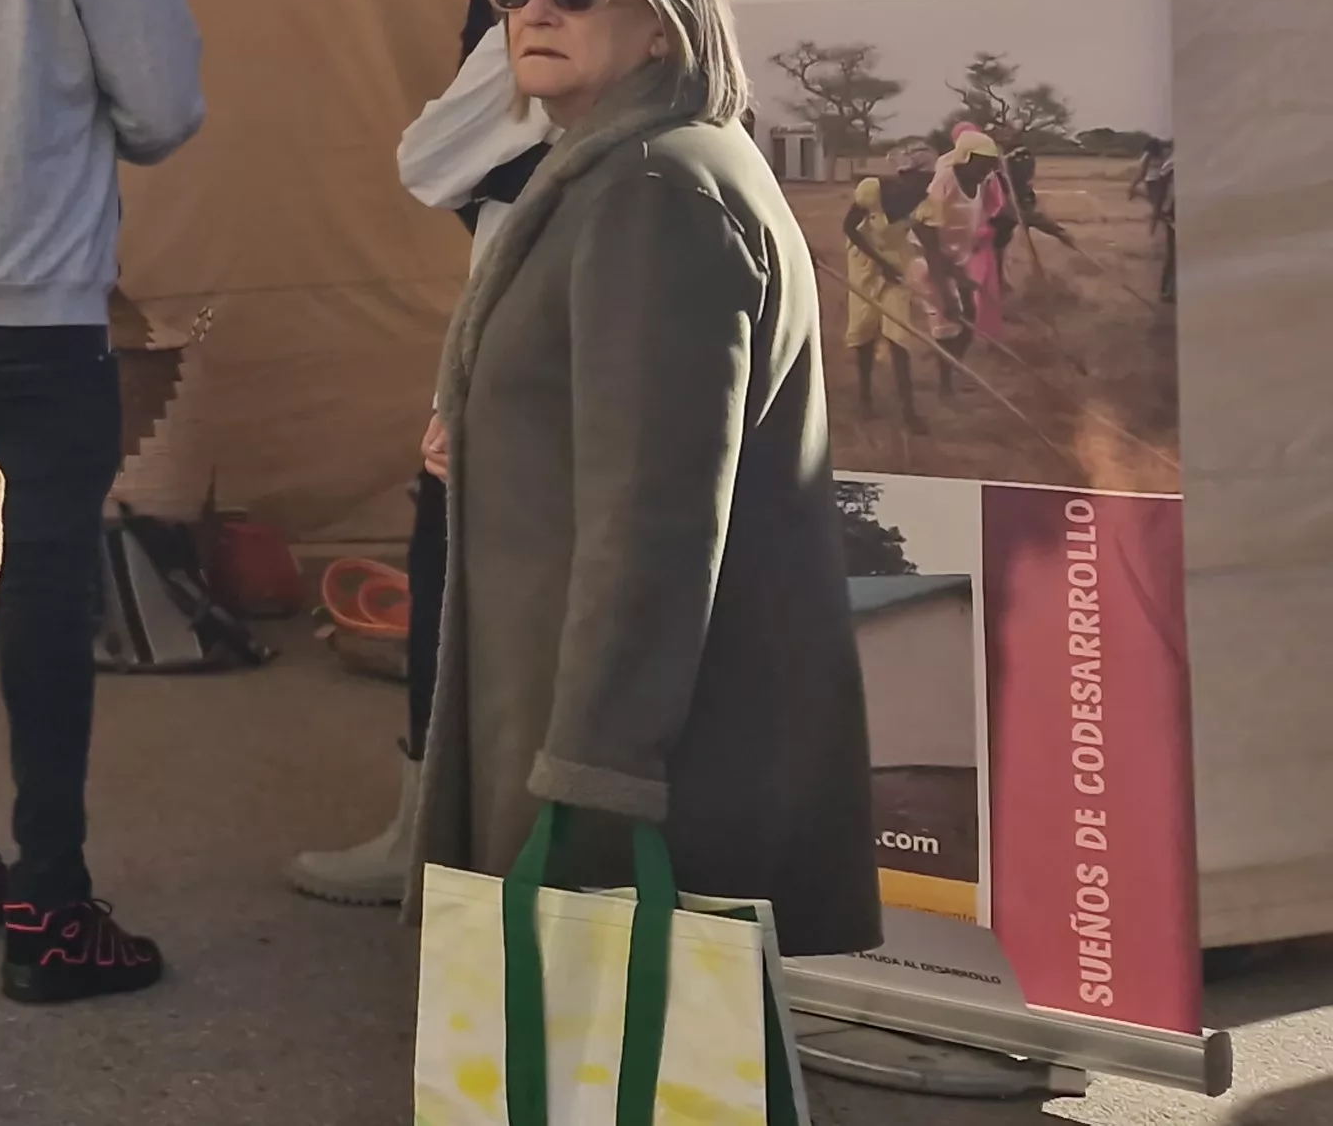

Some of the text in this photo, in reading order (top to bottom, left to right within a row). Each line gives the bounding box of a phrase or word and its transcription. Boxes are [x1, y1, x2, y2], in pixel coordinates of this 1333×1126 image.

[1064, 498, 1114, 1007] SUEÑOS DE CODESARRROLLO
[903, 959, 919, 970] AL
[920, 963, 1001, 984] DESARROLLO
